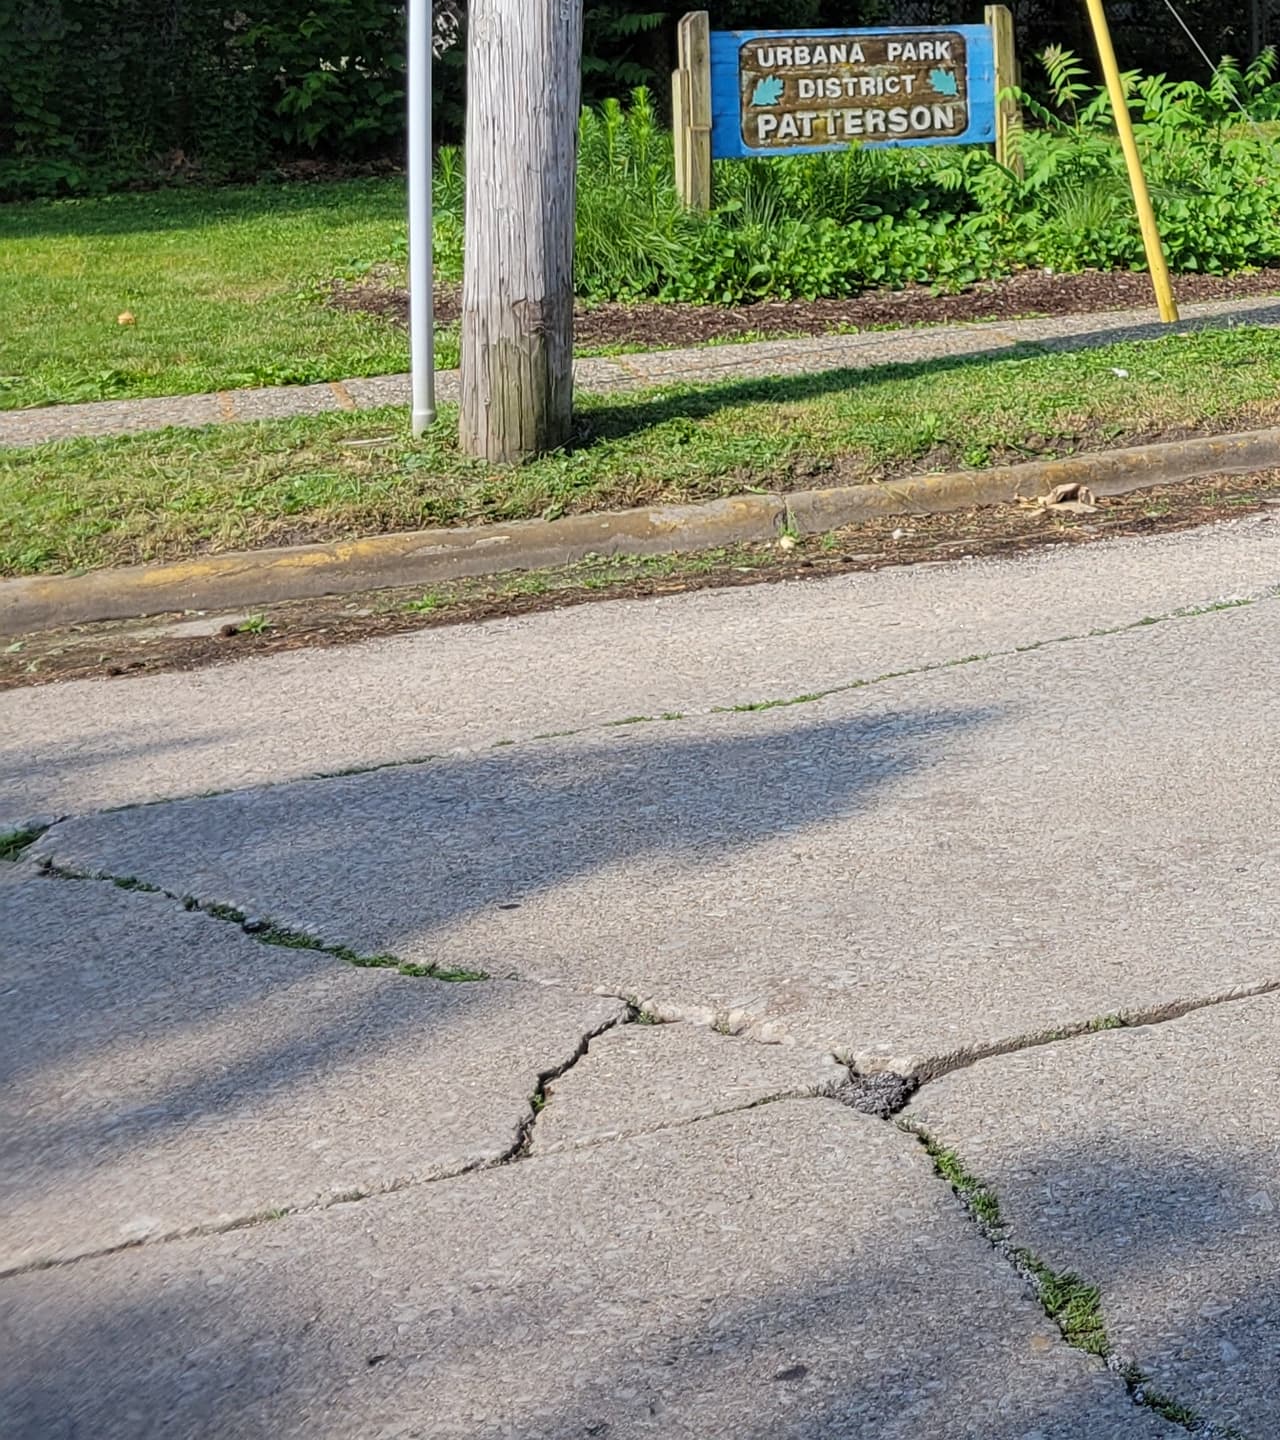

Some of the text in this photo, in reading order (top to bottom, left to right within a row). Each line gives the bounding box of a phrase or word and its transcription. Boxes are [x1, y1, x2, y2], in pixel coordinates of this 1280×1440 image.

[758, 41, 950, 67] URBANA PARK
[798, 75, 916, 98] DISTRICT
[757, 105, 954, 139] PATTERSON
